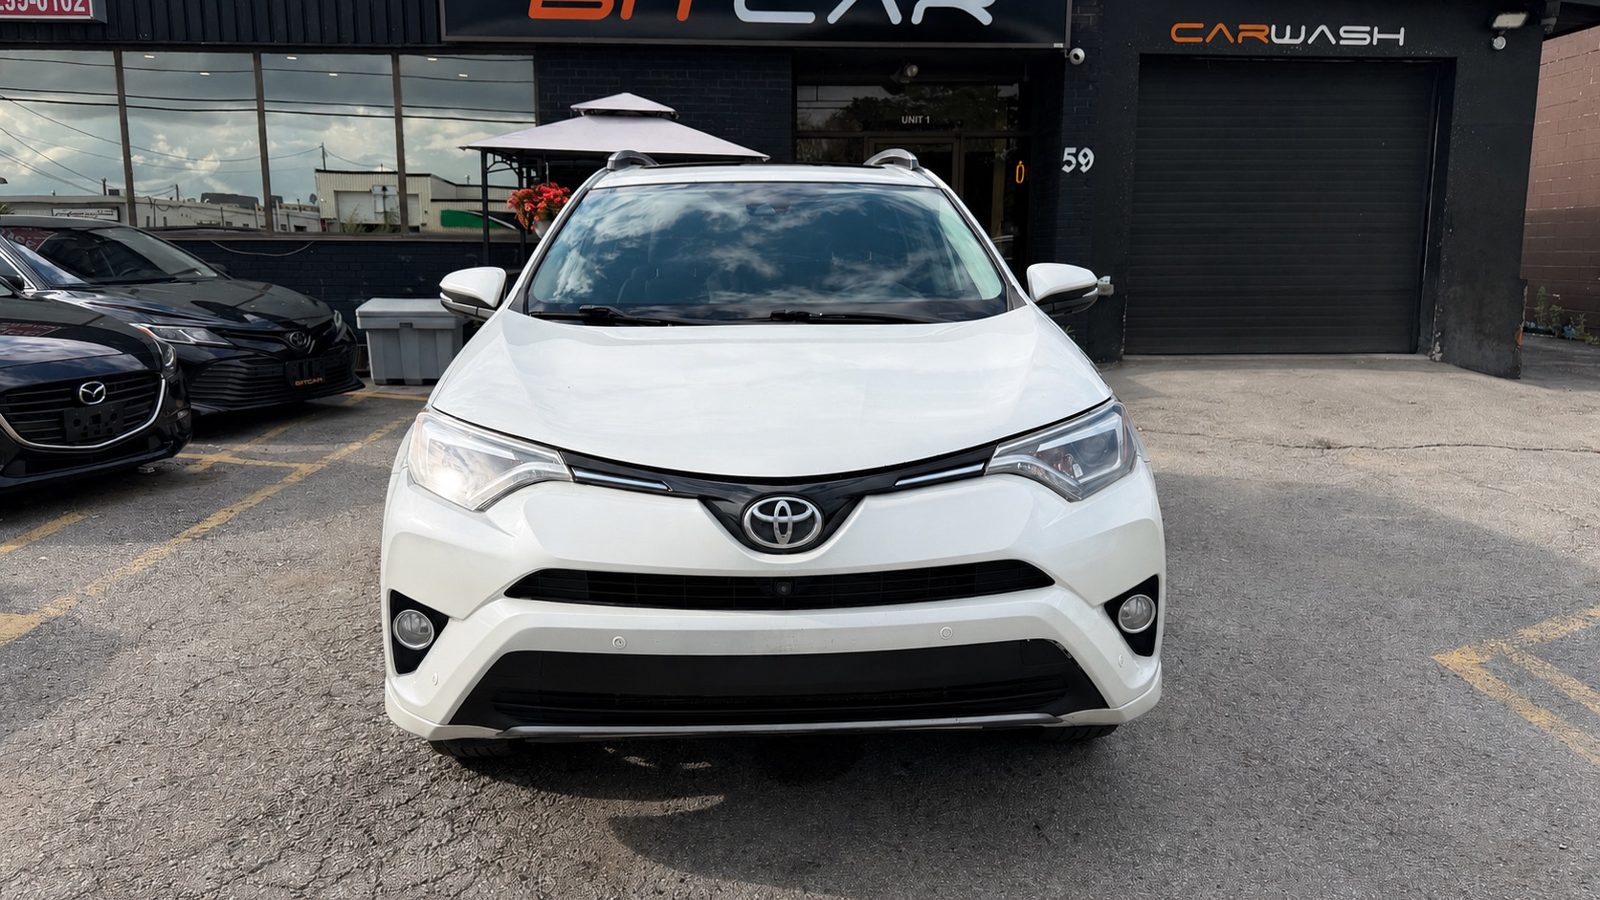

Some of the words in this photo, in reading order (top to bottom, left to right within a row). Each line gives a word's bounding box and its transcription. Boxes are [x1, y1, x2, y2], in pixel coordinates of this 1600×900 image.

[1170, 22, 1405, 46] CARWASH
[901, 115, 924, 125] UNIT
[925, 115, 930, 124] 1
[1061, 147, 1095, 173] 59
